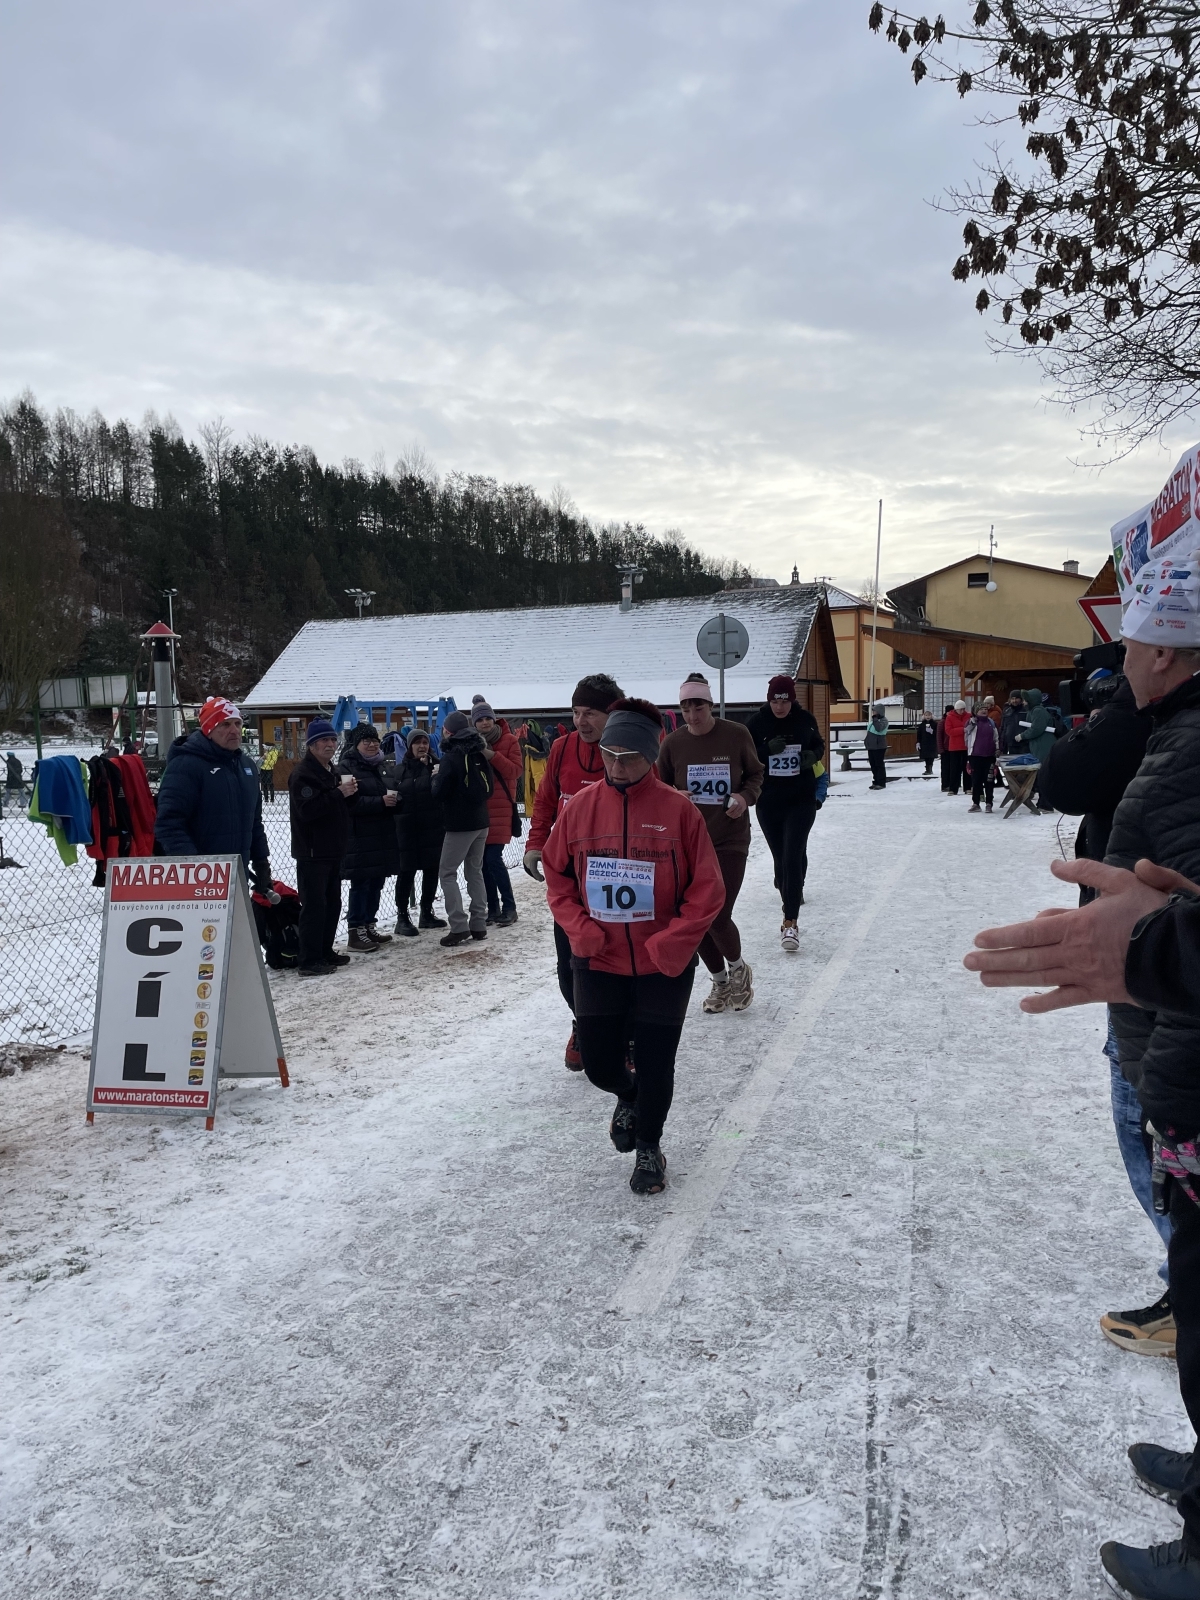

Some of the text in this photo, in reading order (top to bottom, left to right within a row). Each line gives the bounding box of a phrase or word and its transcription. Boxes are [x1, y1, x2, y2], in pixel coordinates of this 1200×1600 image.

[771, 757, 798, 769] 239
[690, 780, 728, 796] 240
[589, 860, 617, 869] ZIMNÍ
[112, 863, 231, 886] MARATON
[588, 870, 629, 878] BĚŽECKÁ
[194, 887, 225, 897] stav
[602, 884, 636, 909] 10
[110, 902, 227, 912] tělovýchovná jednota Úpice
[122, 917, 184, 1082] CÍL
[97, 1091, 205, 1104] www.maratonstav.cz
